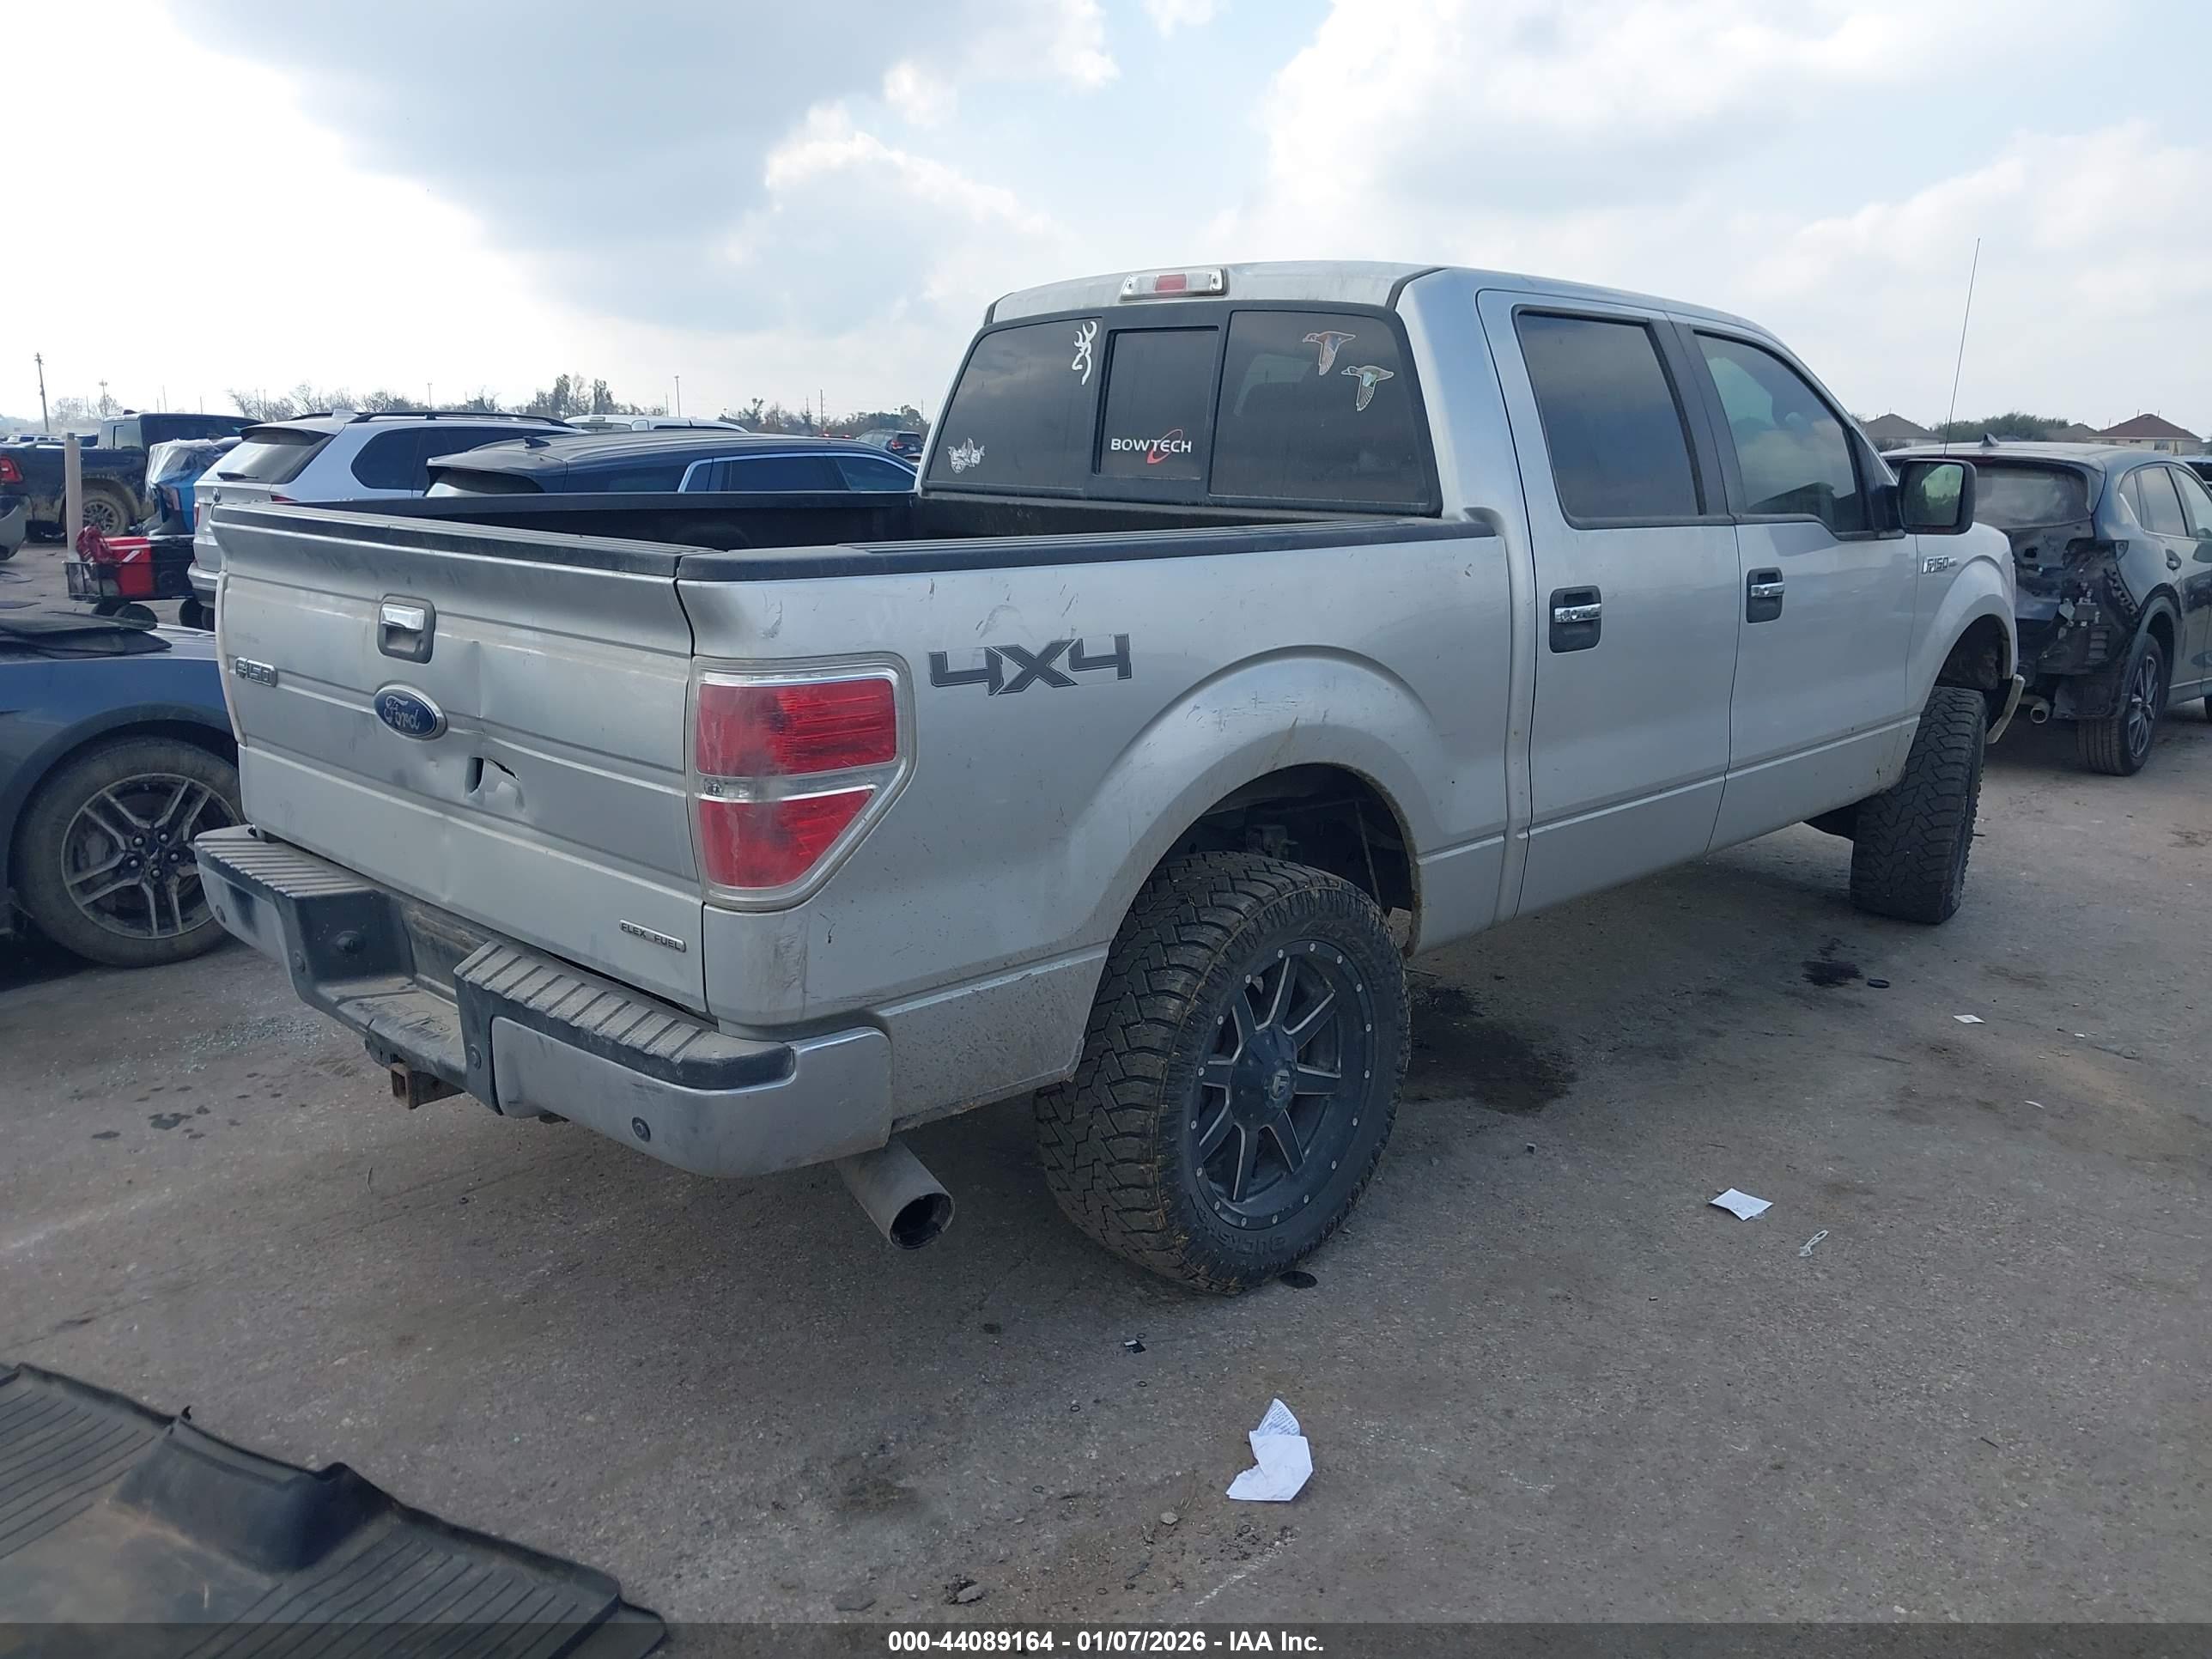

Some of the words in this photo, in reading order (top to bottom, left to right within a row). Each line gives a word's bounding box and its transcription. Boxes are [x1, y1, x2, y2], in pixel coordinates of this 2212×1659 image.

[1110, 437, 1192, 453] BOWTECH
[383, 695, 420, 731] Ford
[620, 922, 647, 939] FLEX
[653, 933, 682, 951] FUEL
